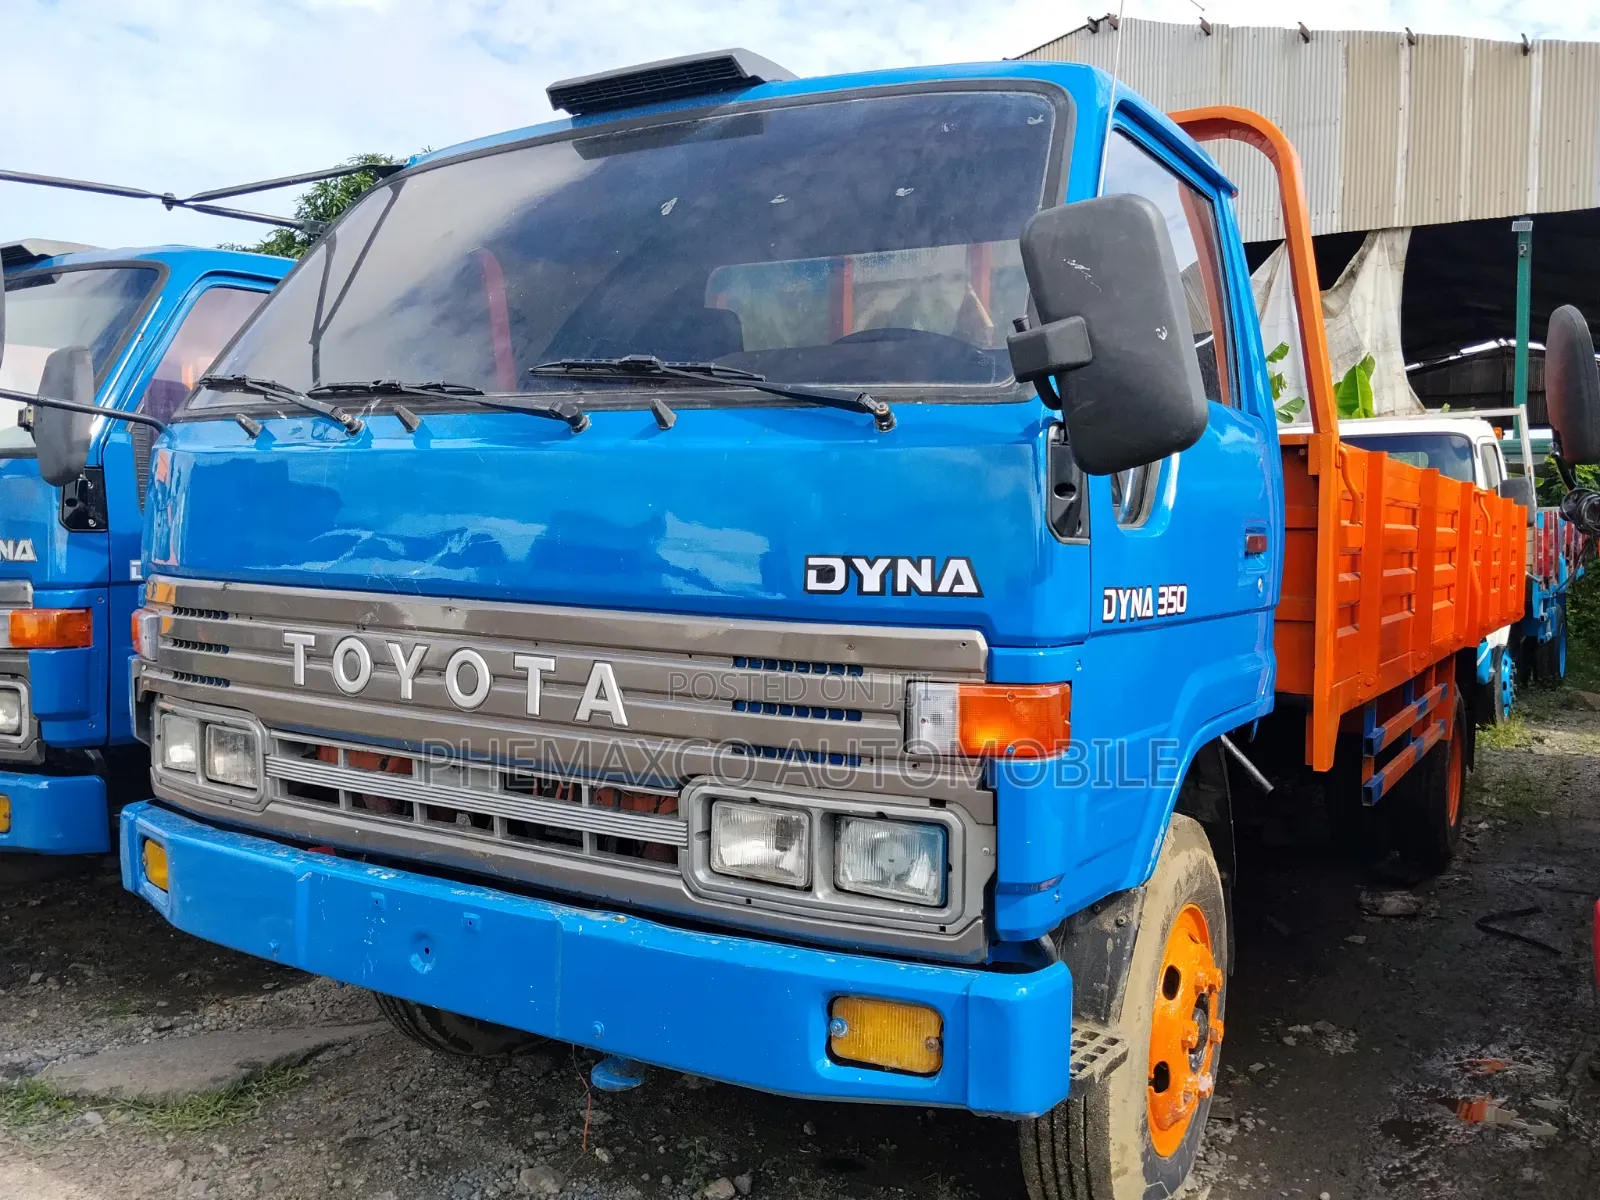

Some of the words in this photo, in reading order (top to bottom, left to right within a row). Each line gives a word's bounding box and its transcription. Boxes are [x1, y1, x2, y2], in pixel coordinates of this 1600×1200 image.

[804, 555, 984, 597] DYNA
[1102, 586, 1154, 623] DYNA
[1157, 584, 1188, 618] 350
[282, 630, 629, 728] TOYOTA
